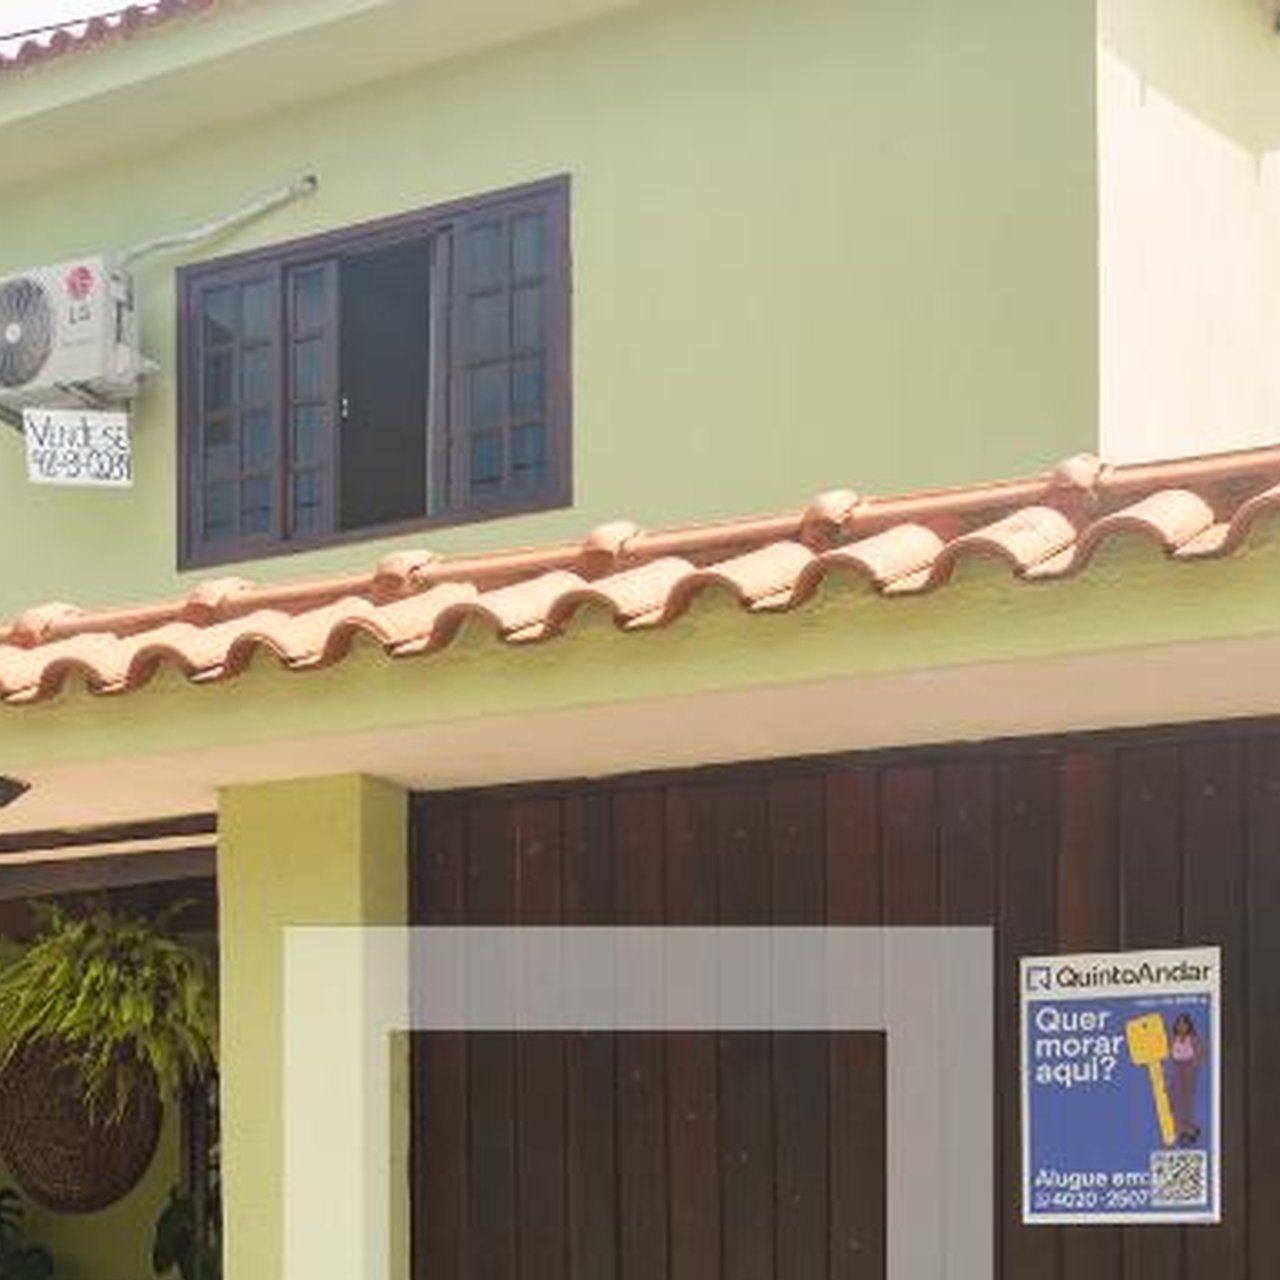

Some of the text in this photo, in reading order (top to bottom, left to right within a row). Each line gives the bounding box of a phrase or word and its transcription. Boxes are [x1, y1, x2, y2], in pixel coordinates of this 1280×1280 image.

[1056, 960, 1211, 988] QuintoAndar
[1035, 1006, 1109, 1032] Quer
[1035, 1034, 1124, 1058] morar
[1035, 1057, 1117, 1087] aqui?
[1035, 1169, 1108, 1190] Alugue
